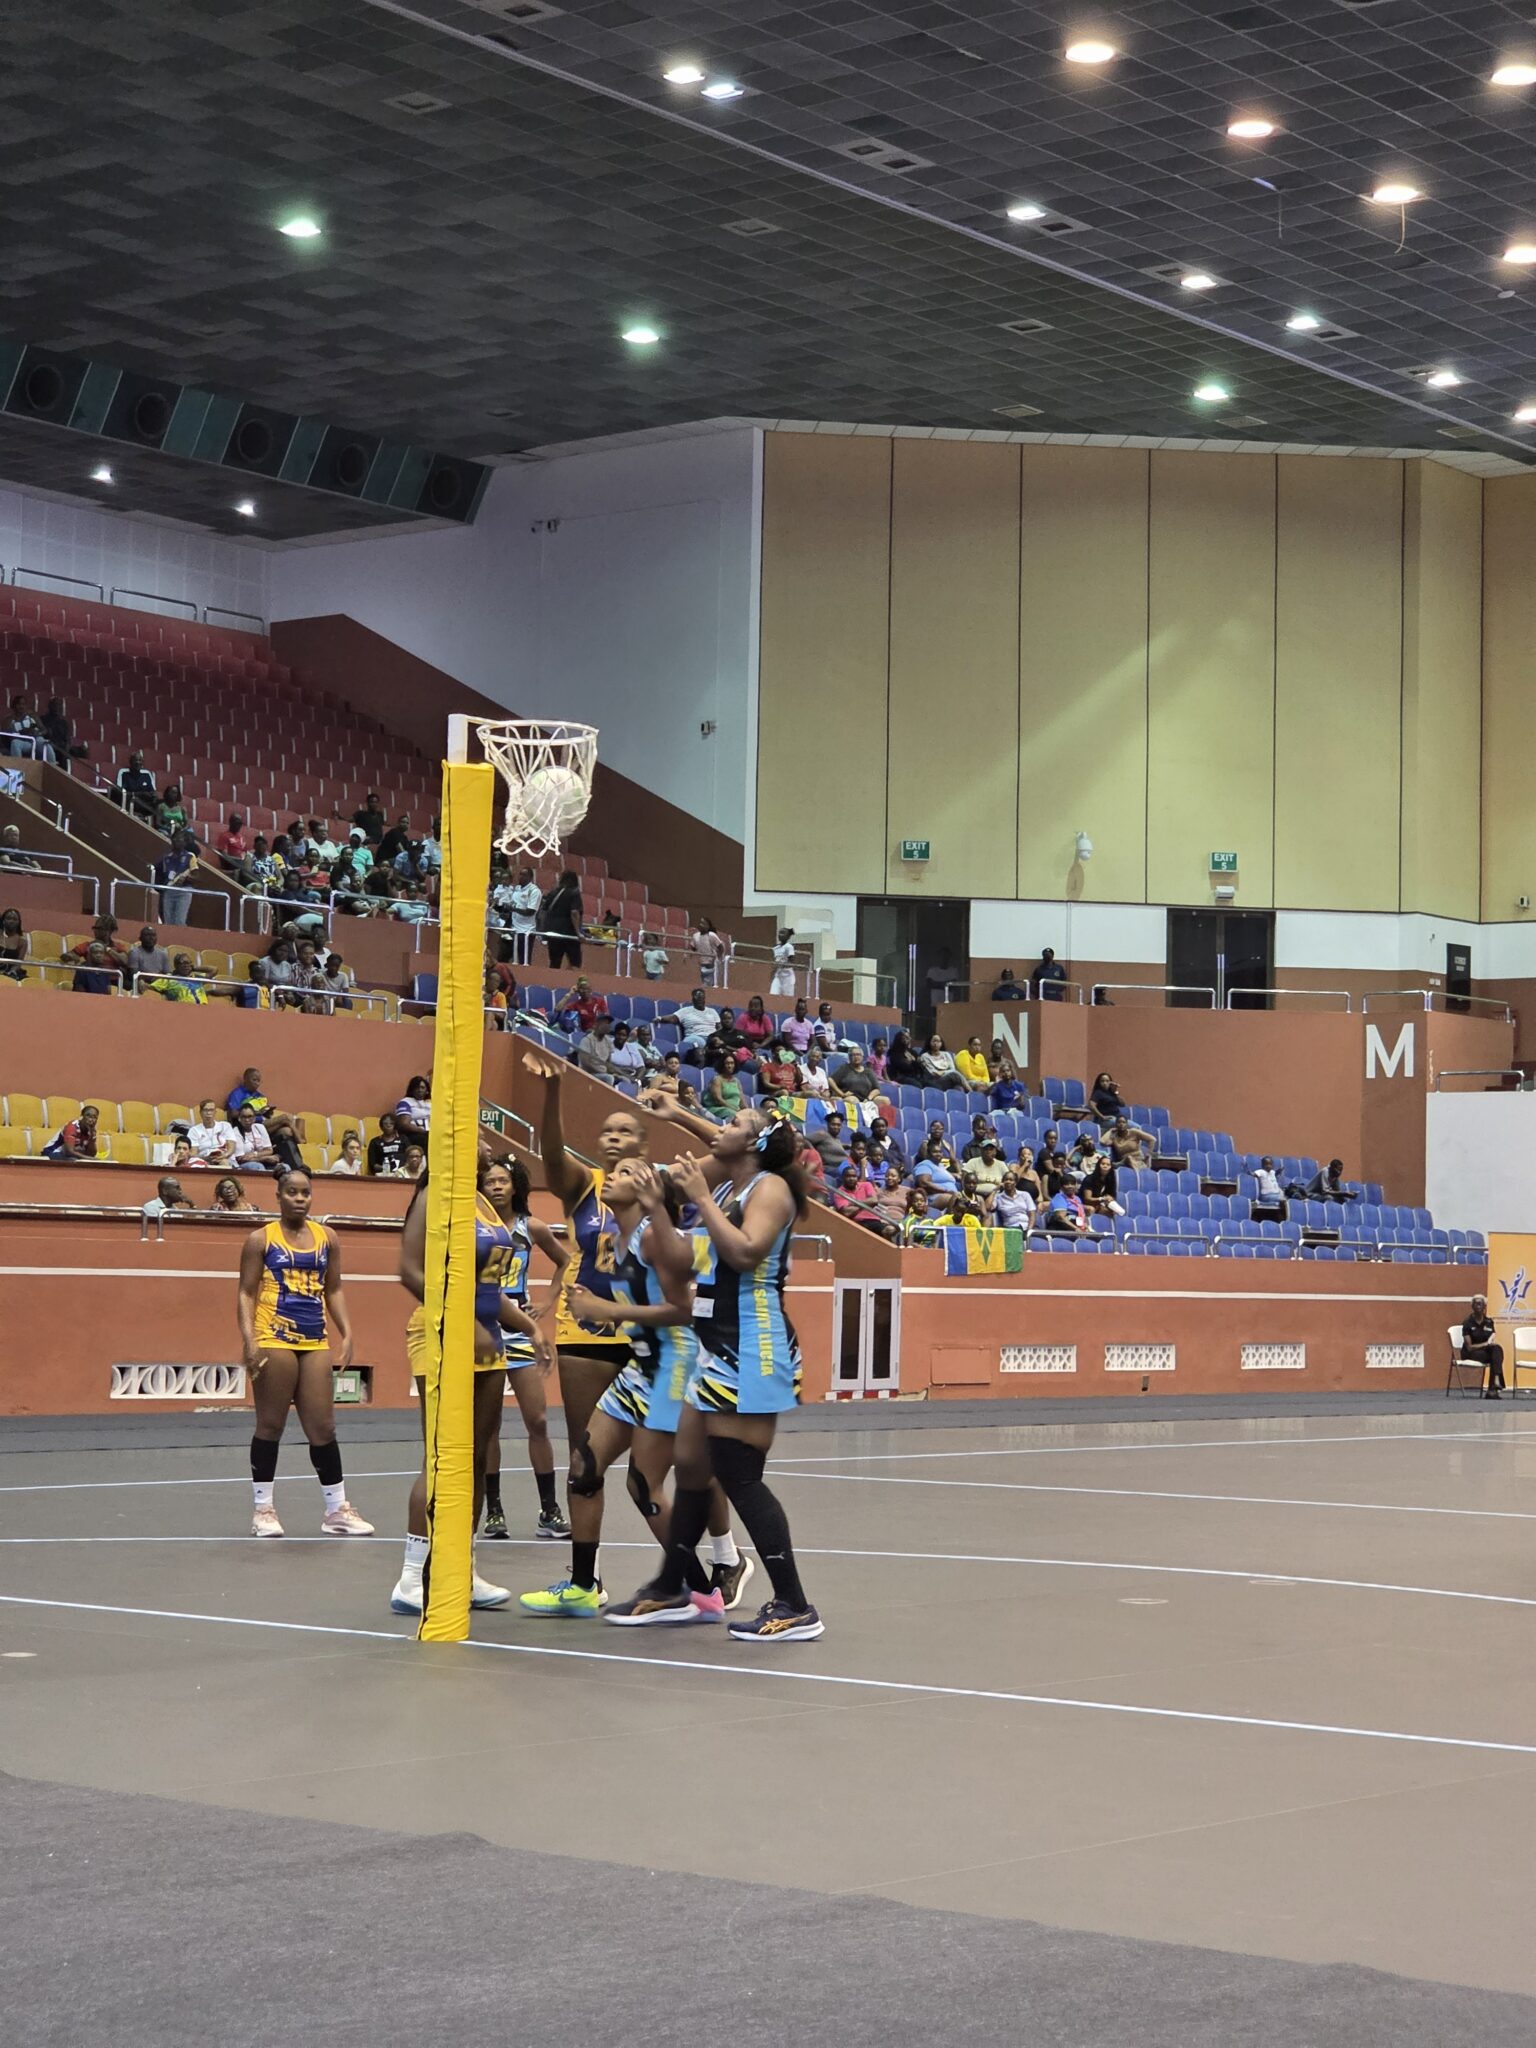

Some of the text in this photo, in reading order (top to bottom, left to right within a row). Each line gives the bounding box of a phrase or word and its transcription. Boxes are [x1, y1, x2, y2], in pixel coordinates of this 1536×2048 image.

[905, 842, 926, 850] EXIT
[913, 850, 919, 859] 5
[1214, 853, 1234, 862] EXIT
[1221, 862, 1227, 870] 5
[992, 1012, 1028, 1068] N
[1365, 1022, 1414, 1078] M
[481, 1110, 500, 1121] EXIT
[594, 1232, 617, 1275] G
[753, 1288, 772, 1329] SAINT
[758, 1333, 775, 1377] LUCIA
